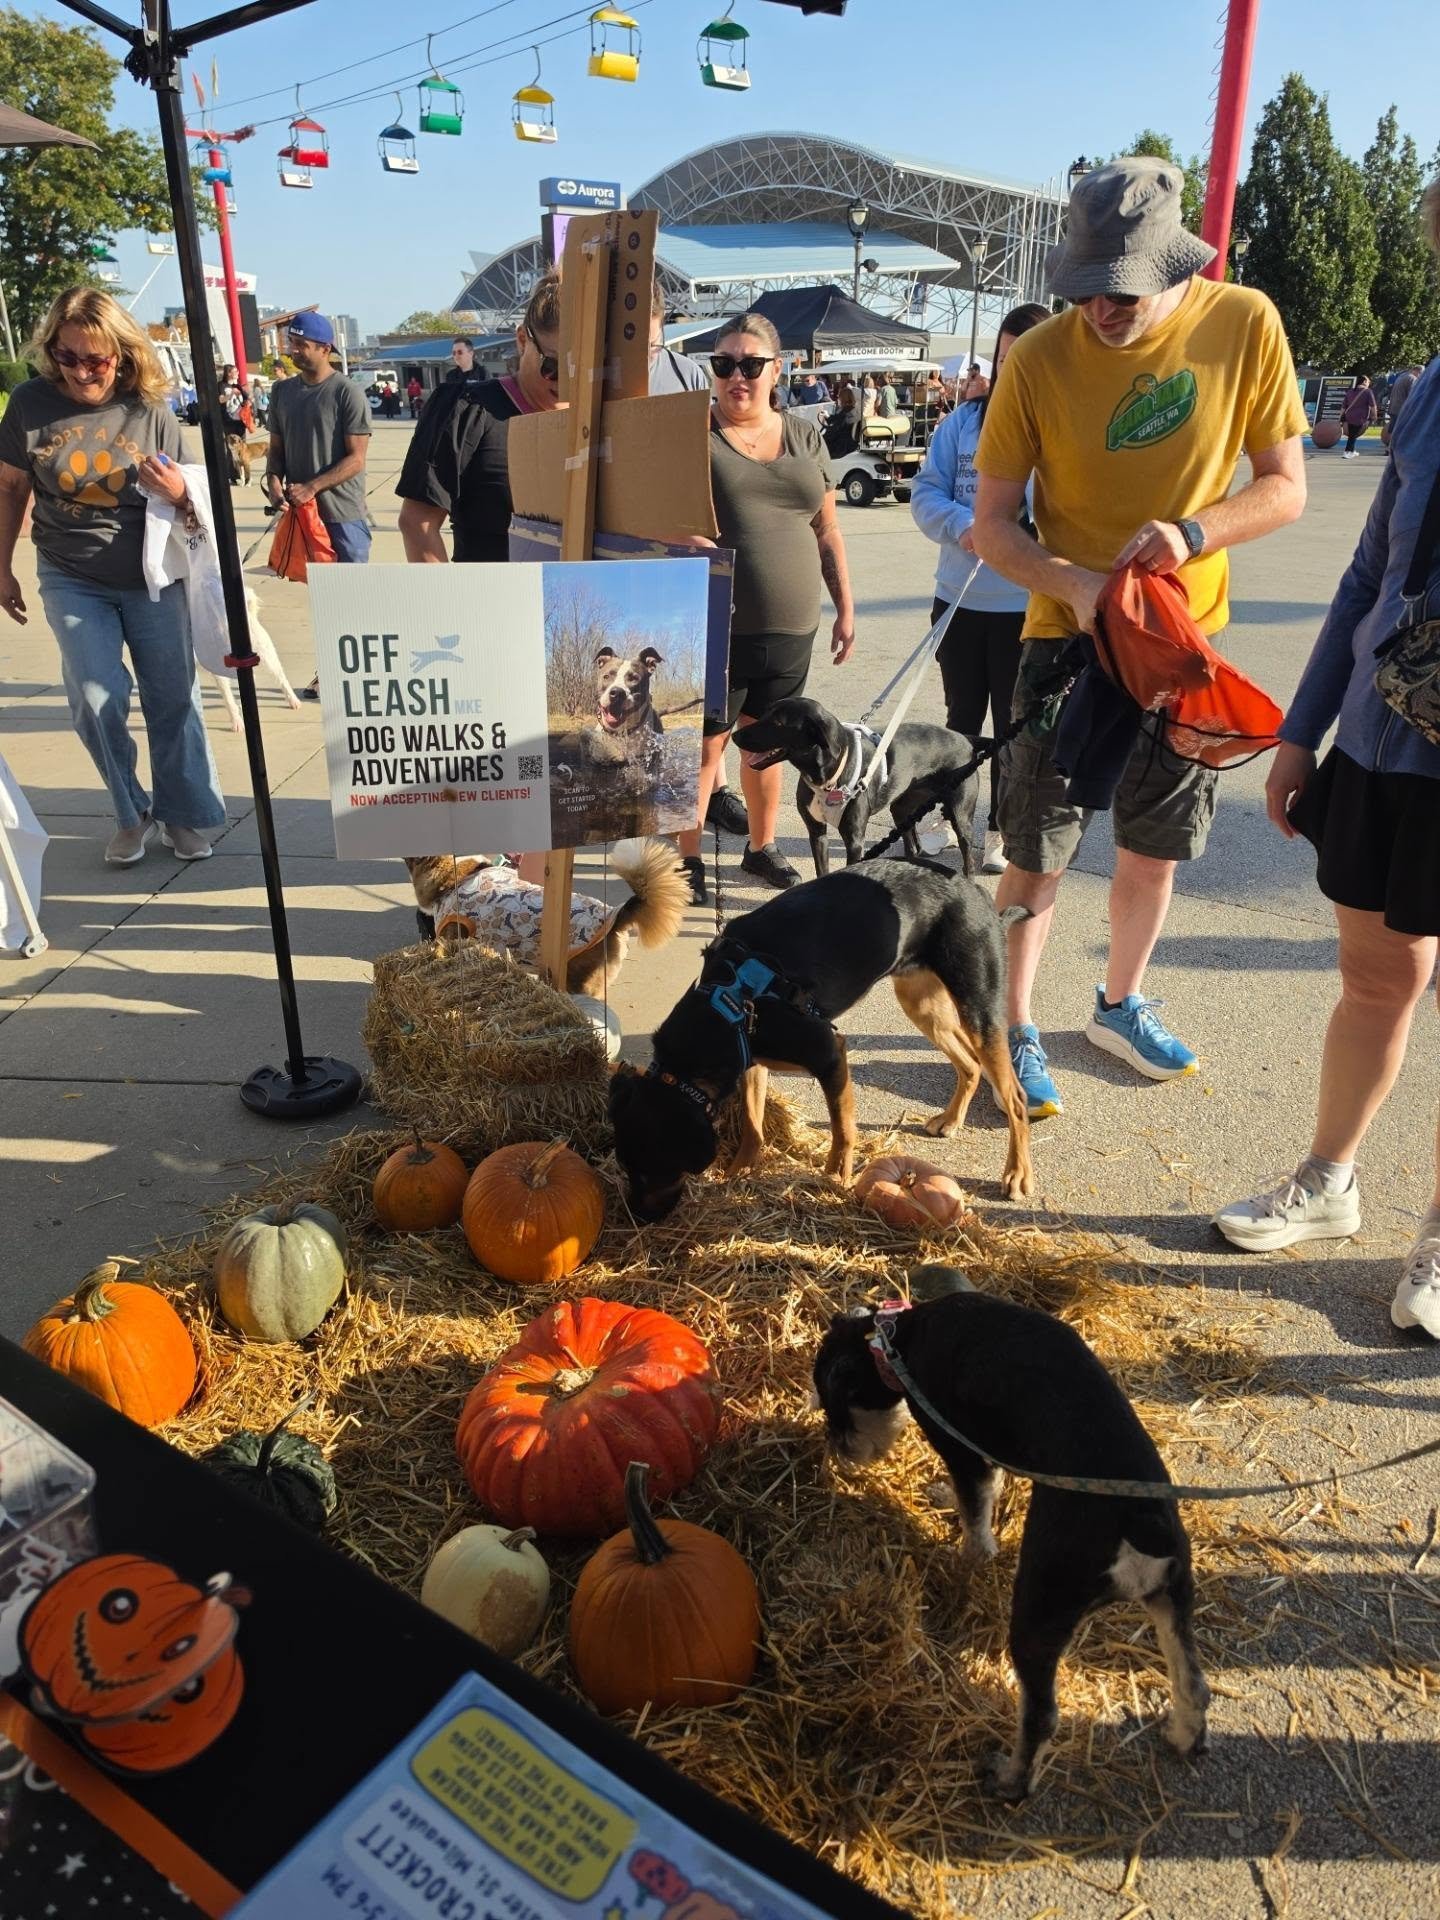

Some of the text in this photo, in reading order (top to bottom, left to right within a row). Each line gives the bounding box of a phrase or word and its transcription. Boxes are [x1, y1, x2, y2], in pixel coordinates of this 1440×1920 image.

[577, 183, 615, 198] Aurora
[840, 347, 904, 356] WELCOME BOOTH
[94, 427, 107, 441] A
[1138, 416, 1165, 439] SEATTLE
[338, 634, 399, 674] OFF
[343, 678, 483, 717] LEASH MKE
[347, 722, 507, 754] DOG WALKS &
[351, 754, 504, 786] ADVENTURES
[481, 787, 531, 801] CLIENTS!
[448, 1729, 489, 1765] GOING
[486, 1759, 504, 1778] IS
[525, 1764, 550, 1789] THE
[481, 1783, 518, 1816] YOUR
[549, 1782, 571, 1804] TO
[427, 1766, 572, 1887] FIRE UP THE DELOREAN
[517, 1811, 556, 1847] GRAB
[570, 1799, 608, 1832] BARK
[386, 1797, 473, 1875] Milwaukee
[553, 1840, 583, 1867] AND
[318, 1861, 355, 1901] PM
[355, 1821, 479, 1920] CROCKETT
